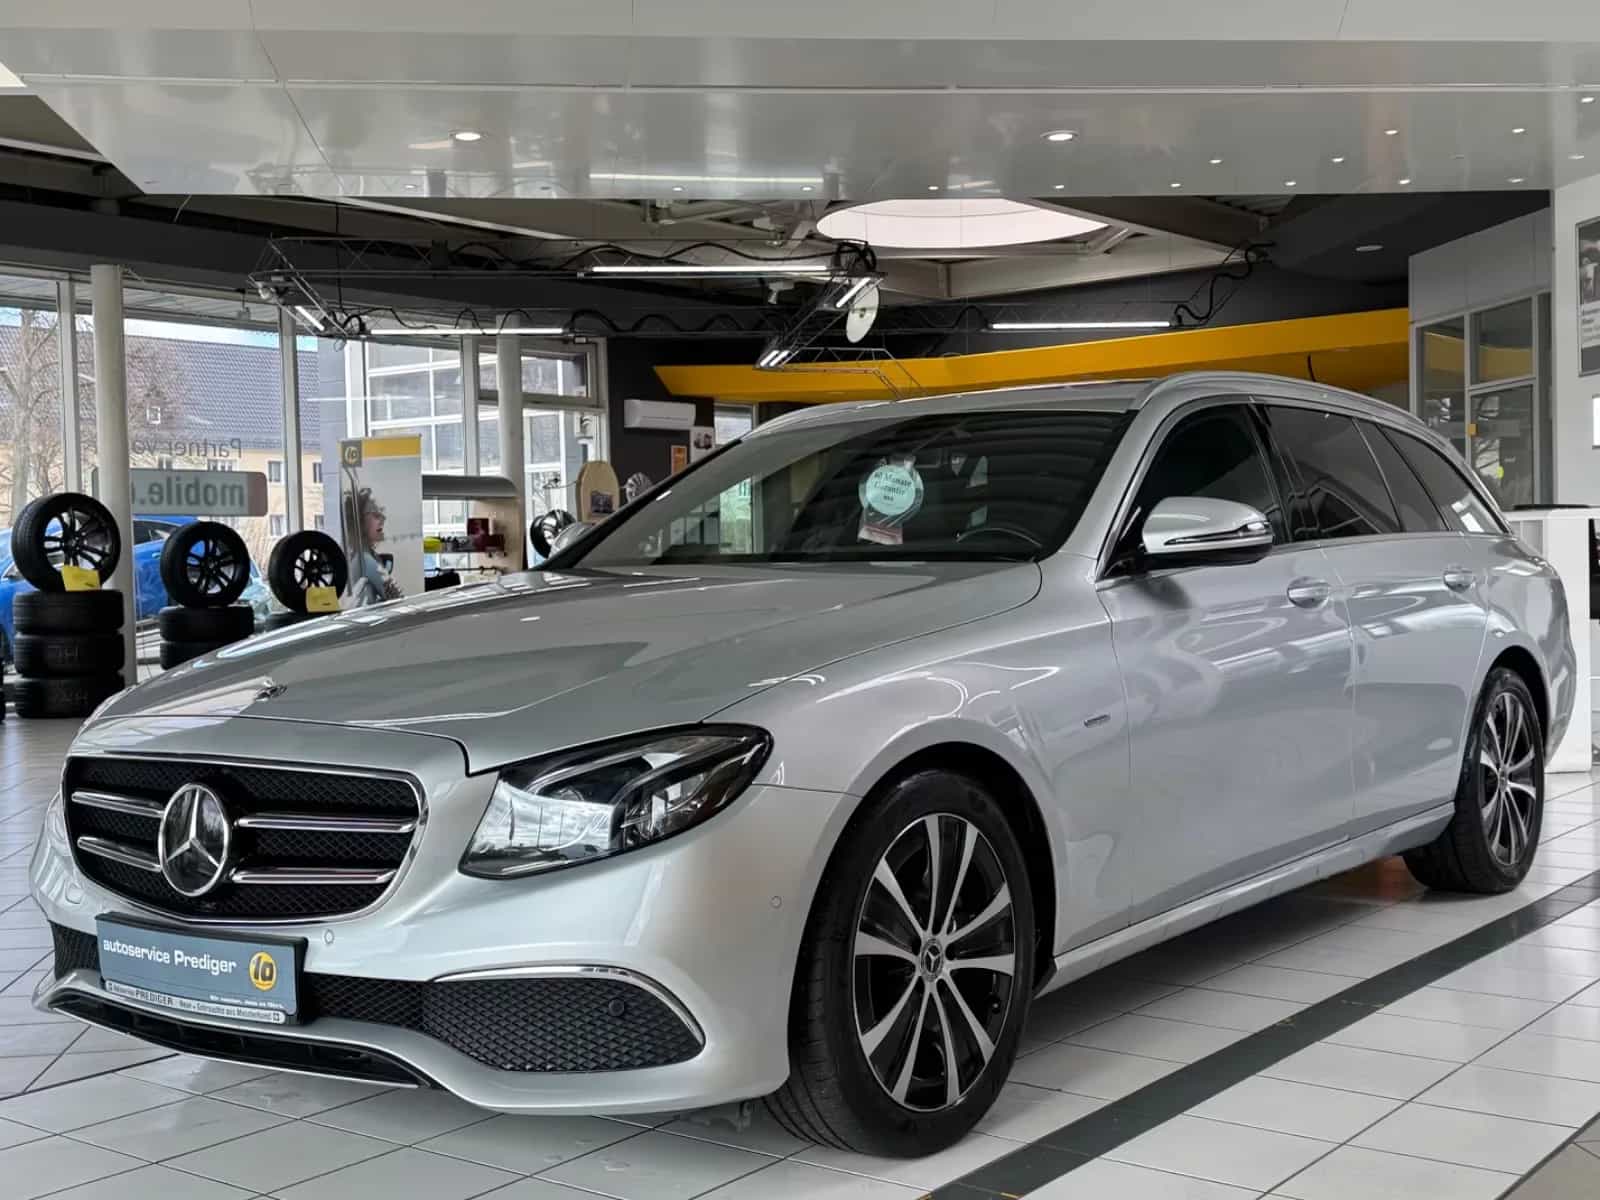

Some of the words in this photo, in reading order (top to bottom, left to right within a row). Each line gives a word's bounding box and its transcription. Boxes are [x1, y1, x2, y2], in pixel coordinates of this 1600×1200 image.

[102, 938, 171, 965] autoservice
[173, 949, 238, 977] Prediger
[135, 988, 173, 1006] PREDIGER
